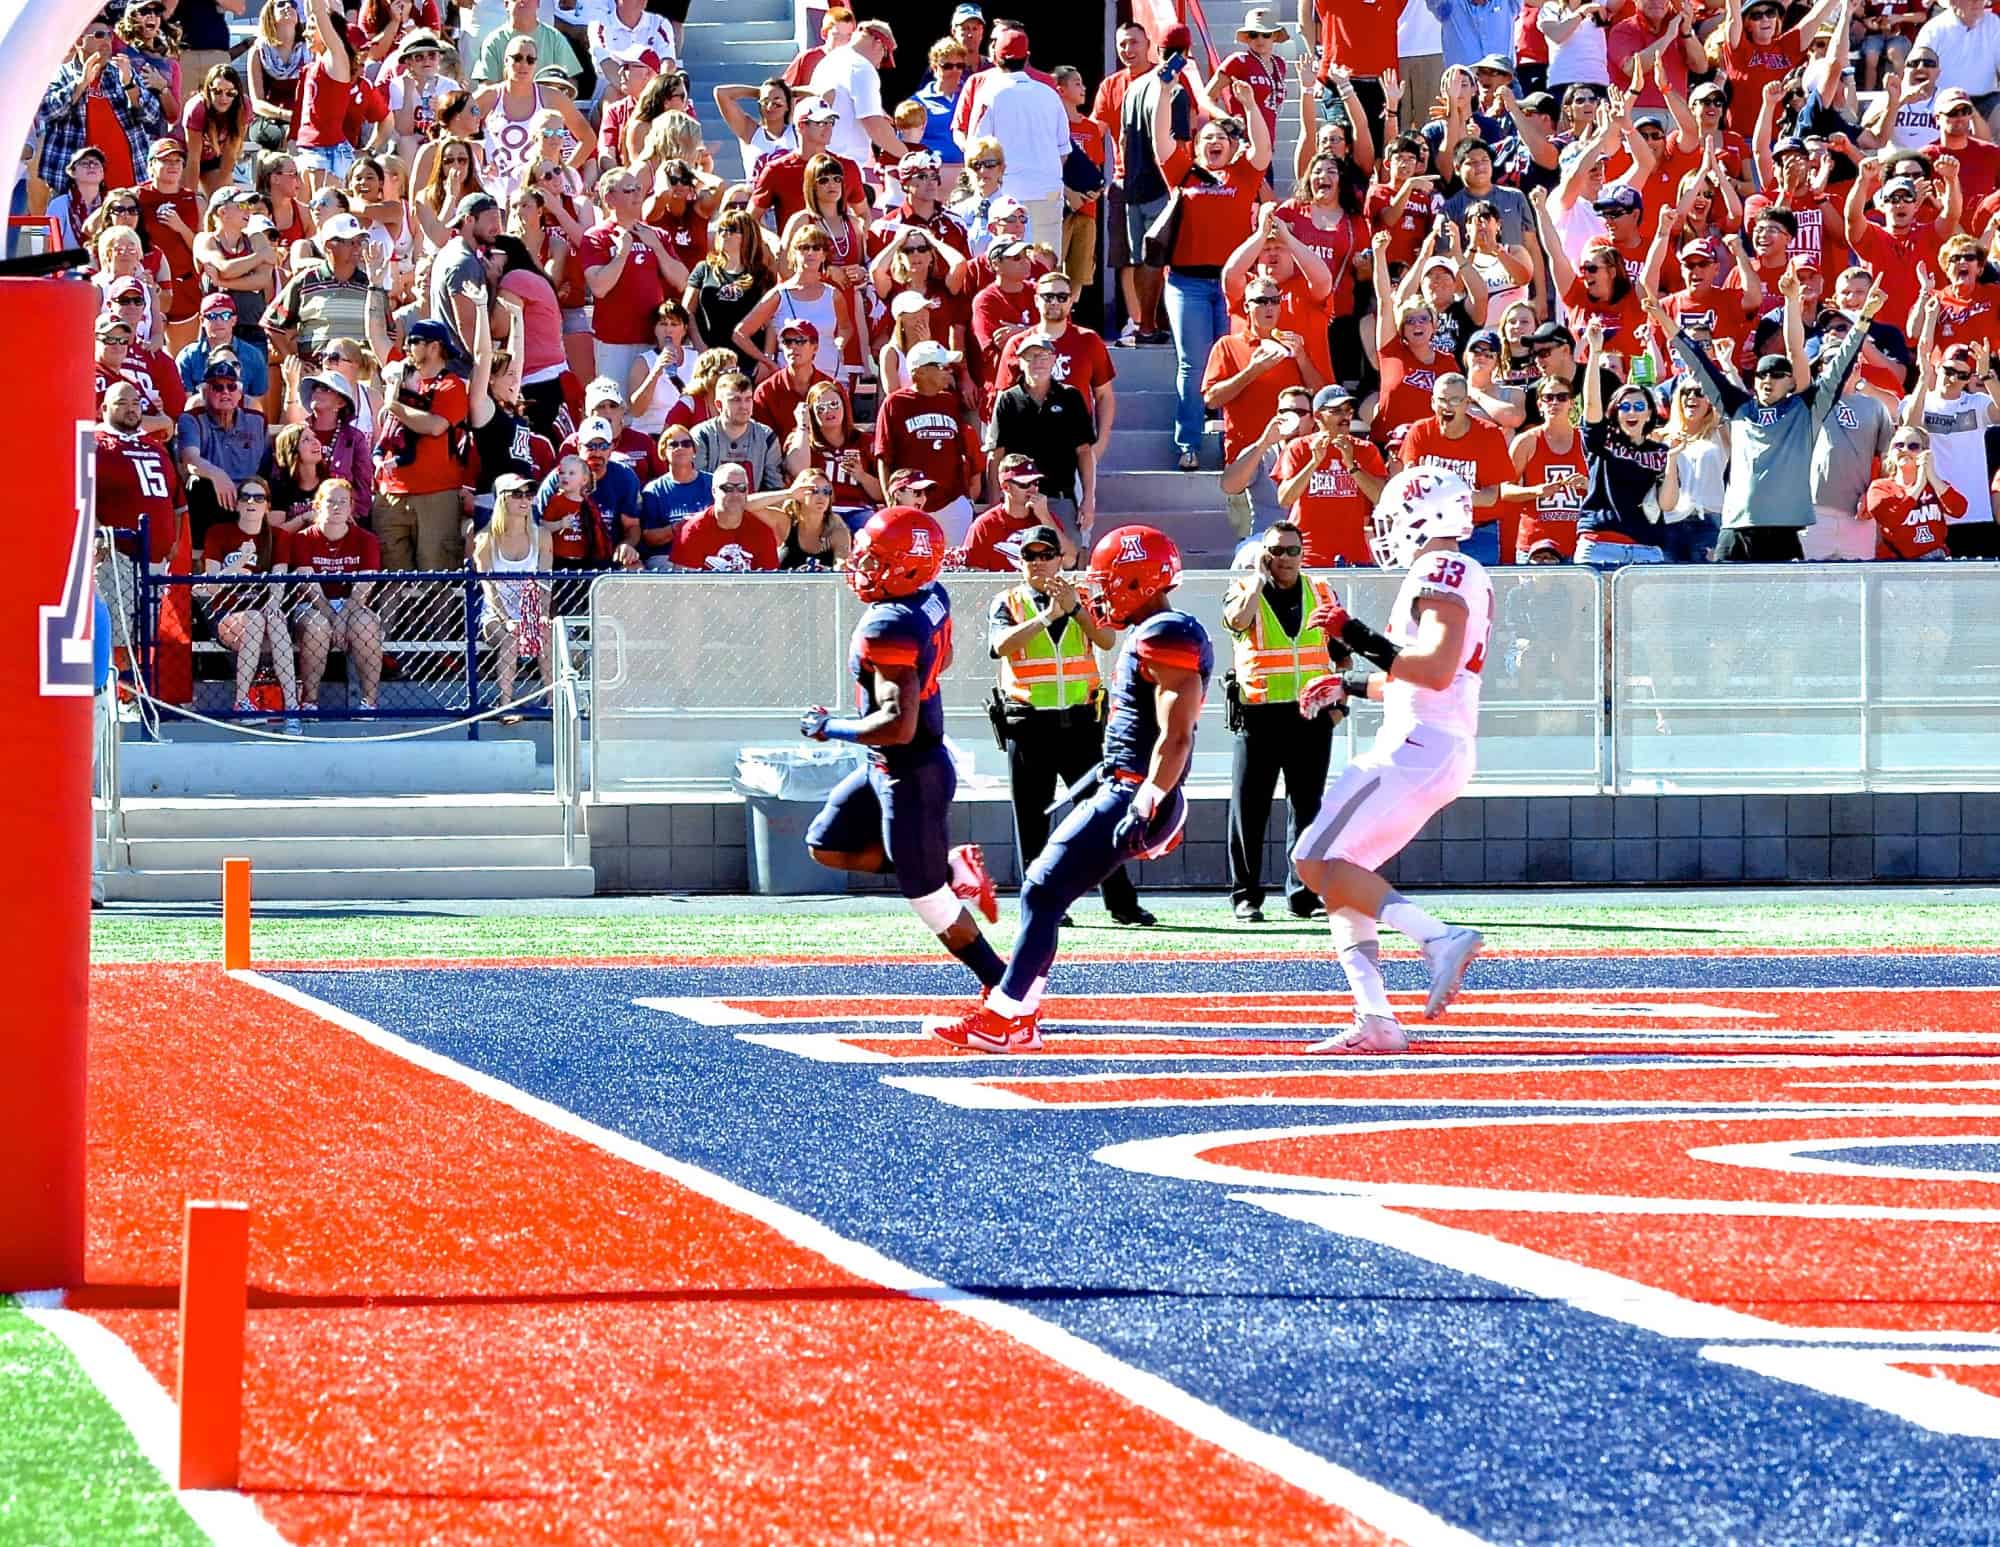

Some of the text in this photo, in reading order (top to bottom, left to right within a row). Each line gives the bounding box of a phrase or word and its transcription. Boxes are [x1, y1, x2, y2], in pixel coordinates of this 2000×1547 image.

[1895, 112, 1940, 129] RIZON
[1758, 408, 1777, 427] A
[1838, 405, 1859, 429] A
[132, 458, 169, 498] 15
[1536, 465, 1582, 511] A
[911, 528, 932, 556] A
[1914, 526, 1935, 543] A
[1118, 535, 1147, 561] A
[1428, 558, 1465, 589] 33
